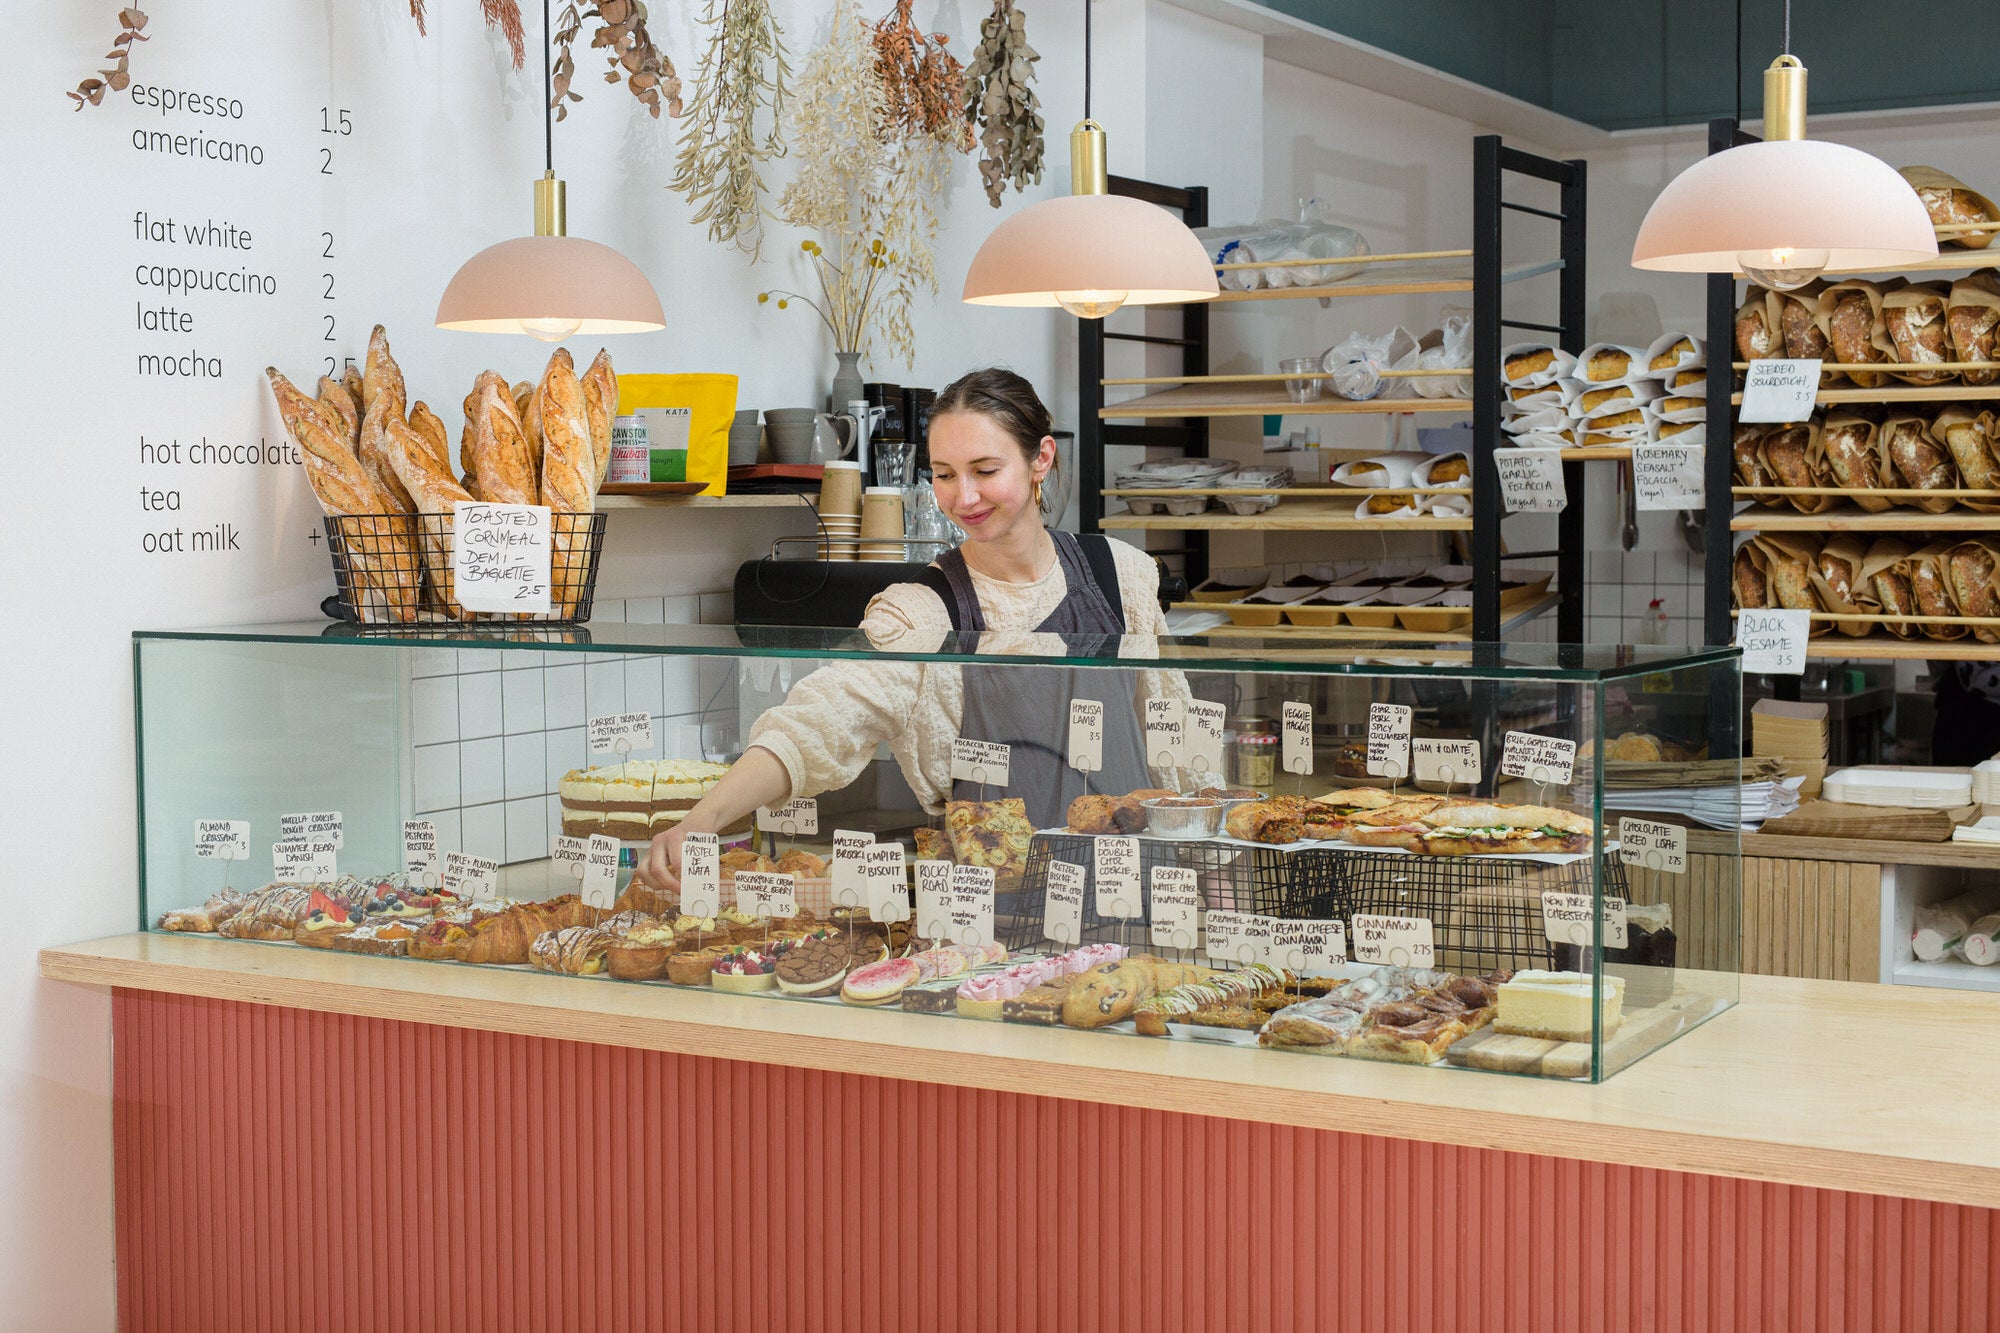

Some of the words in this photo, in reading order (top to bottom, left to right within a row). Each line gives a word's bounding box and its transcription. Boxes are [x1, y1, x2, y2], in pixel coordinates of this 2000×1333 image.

[131, 83, 243, 119] espresso
[320, 106, 352, 136] 1.5
[132, 129, 264, 165] americano
[320, 148, 333, 175] 2
[133, 211, 176, 243] flat
[184, 218, 252, 250] white
[321, 232, 335, 258] 2
[135, 264, 277, 296] cappuccino
[322, 273, 336, 300] 2
[137, 301, 193, 333] latte
[323, 315, 336, 341] 2
[138, 349, 222, 378] mocha
[1755, 364, 1796, 375] SEEDED
[665, 408, 689, 416] KATA
[612, 428, 647, 439] CAWSTON
[140, 436, 181, 464] hot
[189, 437, 303, 465] chocolate
[1635, 449, 1688, 461] ROSEMARY
[1498, 457, 1533, 468] POTATO
[1502, 469, 1541, 479] GARLIC
[140, 486, 181, 511] tea
[461, 505, 538, 526] TOASTED
[142, 527, 184, 553] oat
[192, 523, 241, 551] milk
[464, 528, 541, 550] CORNMEAL
[460, 550, 508, 565] DEMI
[462, 565, 536, 583] BAGUETTE
[514, 585, 547, 599] 2.5
[1743, 614, 1786, 634] BLACK
[1742, 636, 1792, 651] SESAME
[1777, 655, 1793, 666] 3.5
[1072, 703, 1102, 715] HARISSA
[1148, 701, 1172, 712] PORK
[1371, 705, 1391, 714] CHAR
[1394, 706, 1408, 715] SIU
[1187, 705, 1225, 720] MACARONI
[1284, 708, 1311, 721] VEGGIE
[1072, 715, 1096, 727] LAMB
[1198, 719, 1211, 729] PIE
[1371, 714, 1391, 723] PORK
[1146, 721, 1180, 733] MUSTARD
[1285, 720, 1310, 734] HAGGIS
[1371, 723, 1393, 733] SPICY
[1089, 732, 1101, 741] 3.5
[1209, 728, 1222, 739] 4.5
[954, 739, 985, 750] FOCACCIA
[1170, 736, 1181, 745] 3.5
[1299, 736, 1310, 747] 3.5
[1413, 744, 1433, 754] HAM
[1462, 758, 1477, 768] 4.5
[281, 816, 308, 825] NUTELLA
[311, 813, 336, 823] COOKIE
[804, 818, 816, 827] 3.5
[199, 821, 231, 832] ALMOND
[405, 821, 430, 831] APRICOT
[241, 841, 246, 850] 3
[558, 838, 582, 849] PLAIN
[591, 839, 613, 852] PAIN
[1098, 838, 1130, 848] PECAN
[1623, 834, 1647, 846] OREO
[1655, 838, 1679, 850] LOAF
[273, 844, 309, 854] SUMMER
[312, 843, 336, 853] BERRY
[685, 844, 715, 858] PASTEL
[1097, 847, 1134, 857] DOUBLE
[286, 853, 314, 862] DANISH
[446, 852, 467, 865] APPLE
[589, 853, 617, 866] SUISSE
[866, 851, 902, 863] EMPIRE
[316, 865, 329, 875] 3.5
[448, 864, 463, 876] PUFF
[467, 868, 486, 878] TART
[603, 868, 616, 878] 3.5
[688, 866, 711, 877] NATA
[868, 866, 901, 878] BISCUIT
[919, 864, 951, 879] ROCKY
[955, 867, 982, 875] LEMON
[1155, 868, 1185, 880] BERRY
[484, 882, 490, 893] 3
[922, 879, 949, 893] ROAD
[1152, 882, 1177, 893] WHITE
[955, 895, 977, 904] TART
[1152, 895, 1197, 907] FINANCIER
[1543, 895, 1563, 907] NEW
[1565, 896, 1586, 908] YORK
[1072, 910, 1079, 919] 3
[1181, 910, 1187, 920] 3
[1207, 914, 1246, 925] CARAMEL
[1207, 924, 1240, 935] BRITTLE
[1271, 922, 1304, 935] CREAM
[1307, 923, 1343, 934] CHEESE
[1356, 917, 1418, 931] CINNAMON
[1364, 929, 1387, 940] BUN
[1615, 926, 1622, 940] 3
[1273, 934, 1328, 946] CINNAMON
[1264, 946, 1270, 956] 3
[1302, 945, 1323, 955] BUN
[1412, 943, 1432, 955] 2.75
[1328, 955, 1346, 965] 2.75
